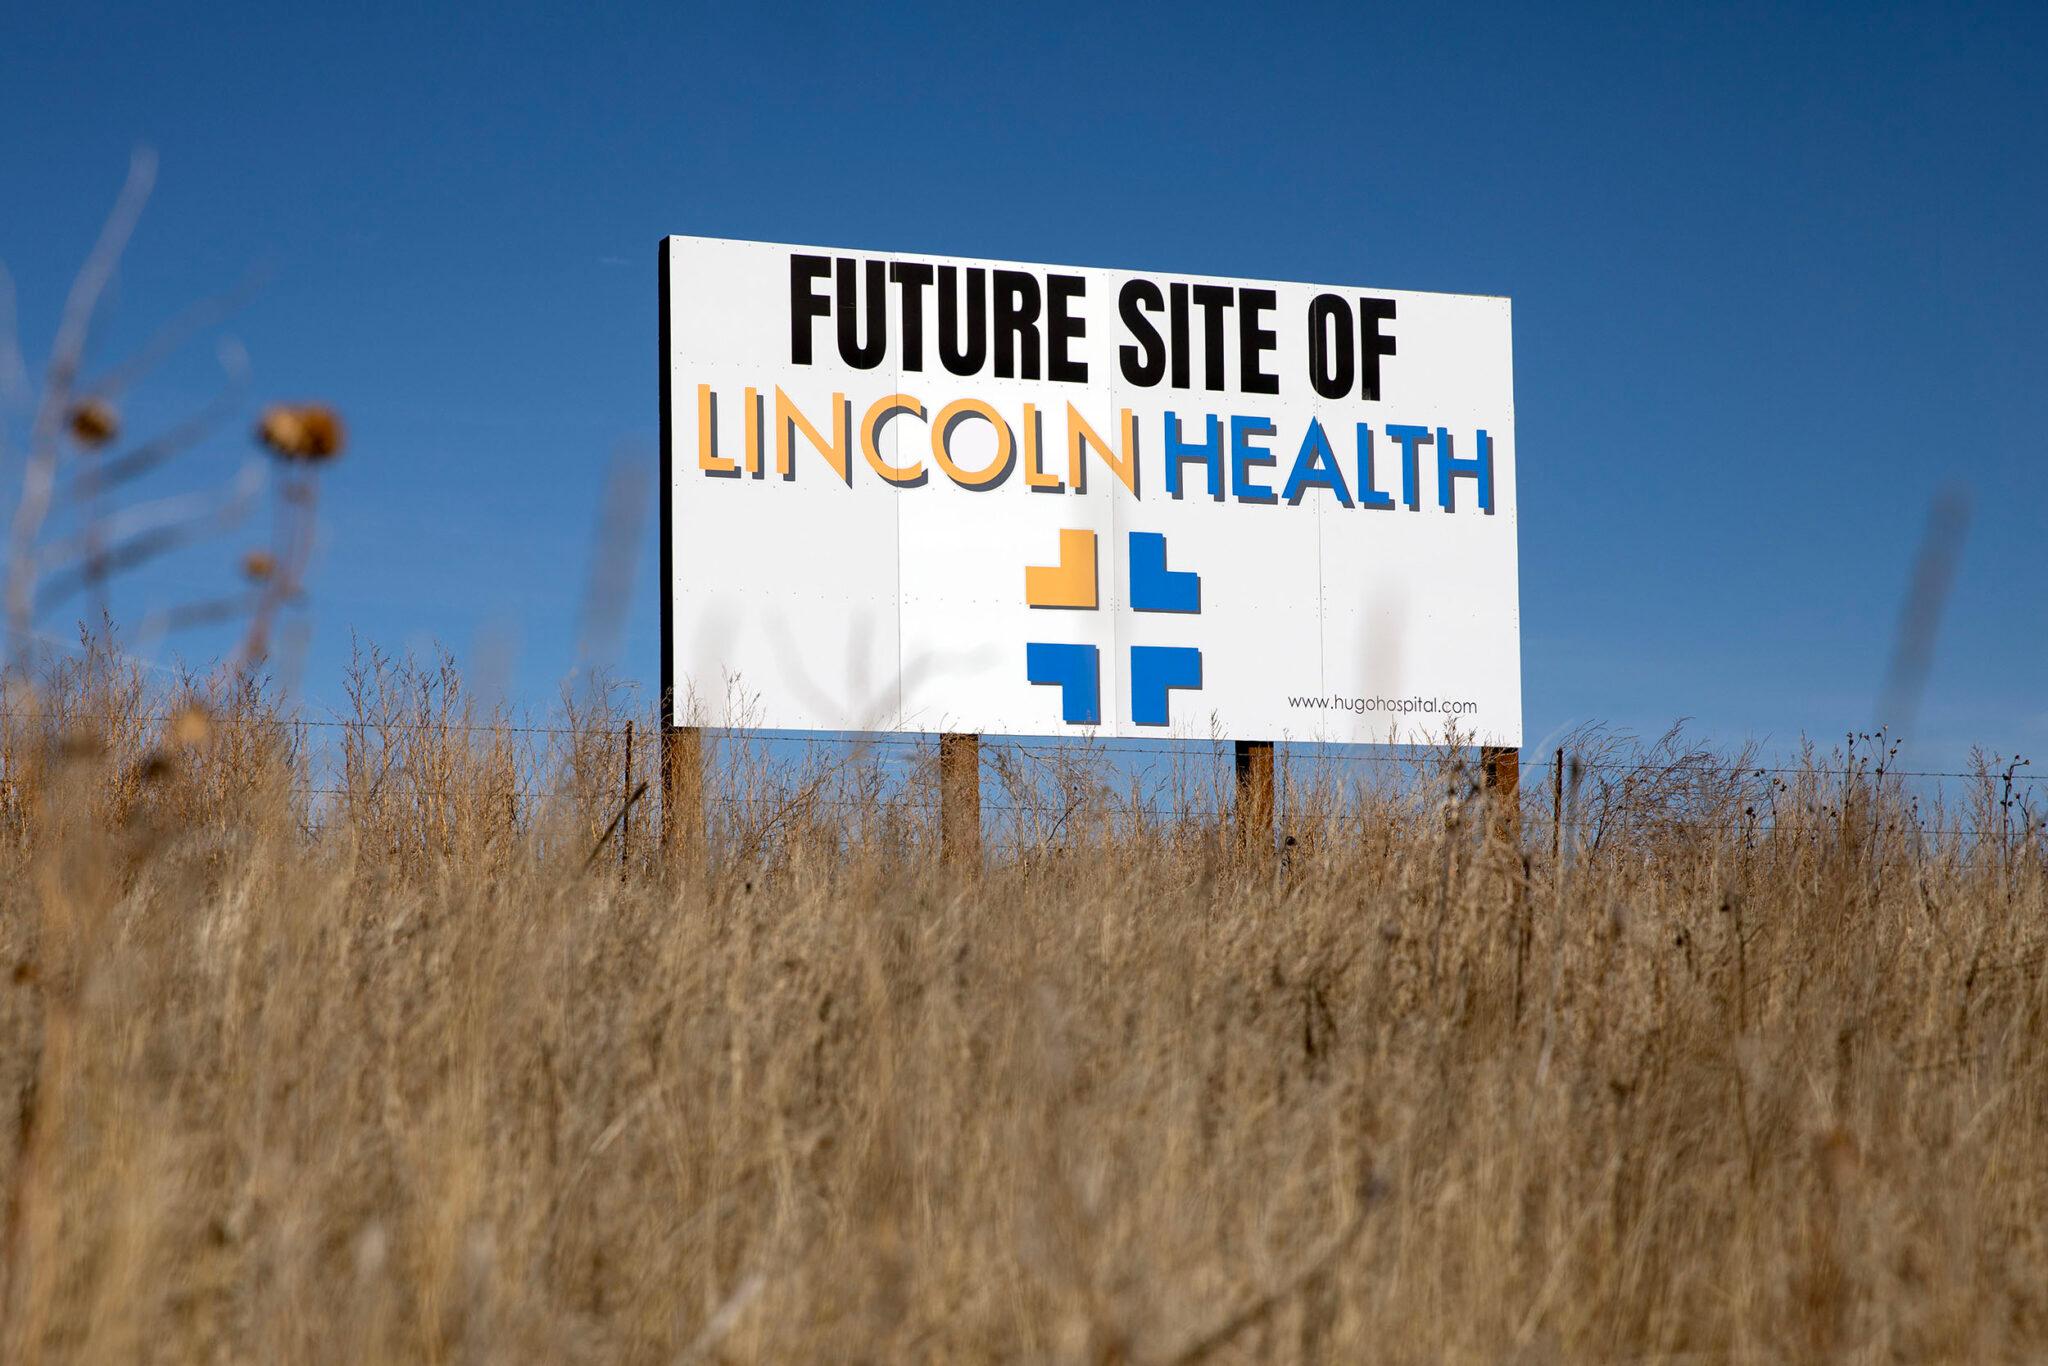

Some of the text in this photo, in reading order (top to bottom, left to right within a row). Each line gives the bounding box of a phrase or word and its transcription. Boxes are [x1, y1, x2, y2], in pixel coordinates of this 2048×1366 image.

[790, 253, 1397, 402] FUTURE SITE OF
[1287, 694, 1478, 716] www.hugohospital.com
